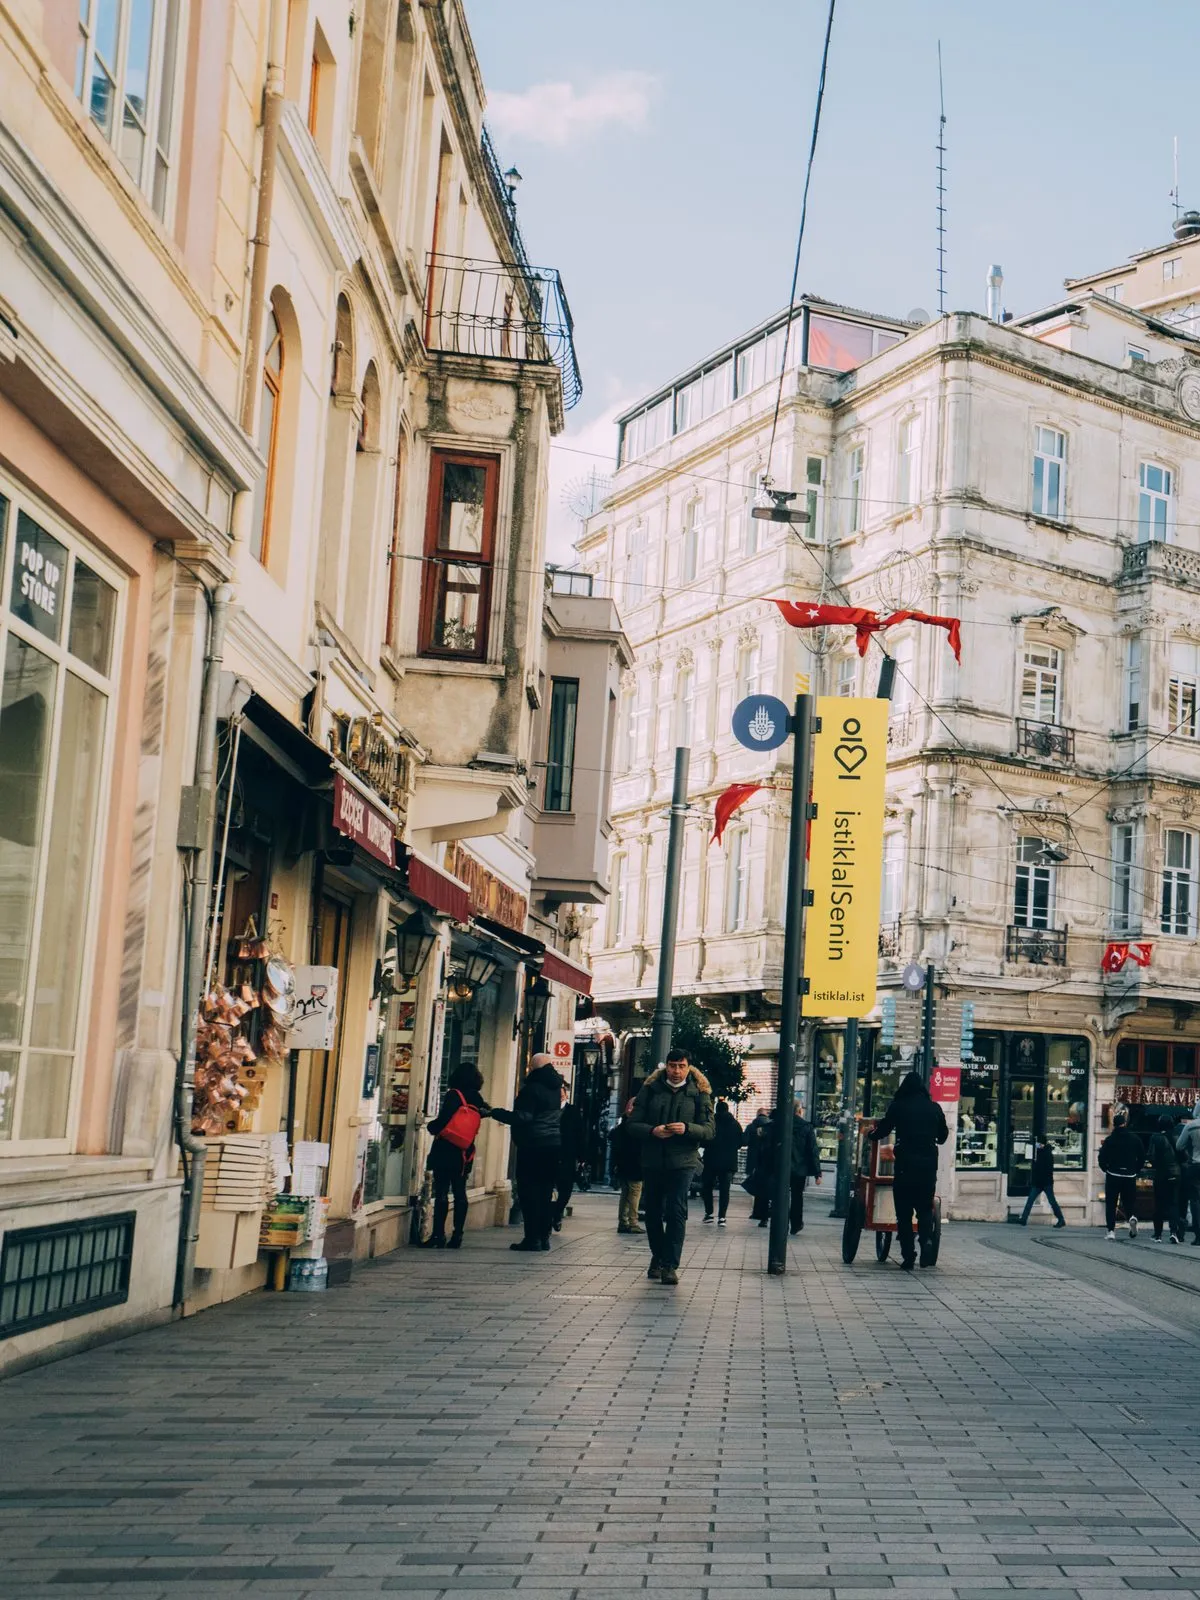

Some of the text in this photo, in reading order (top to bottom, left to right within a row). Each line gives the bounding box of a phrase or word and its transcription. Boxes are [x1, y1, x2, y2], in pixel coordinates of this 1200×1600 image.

[21, 541, 60, 589] POP UP
[21, 571, 56, 616] STORE
[828, 811, 861, 961] istiklalSenin
[813, 990, 865, 1002] istiklal.ist
[558, 1044, 567, 1055] K
